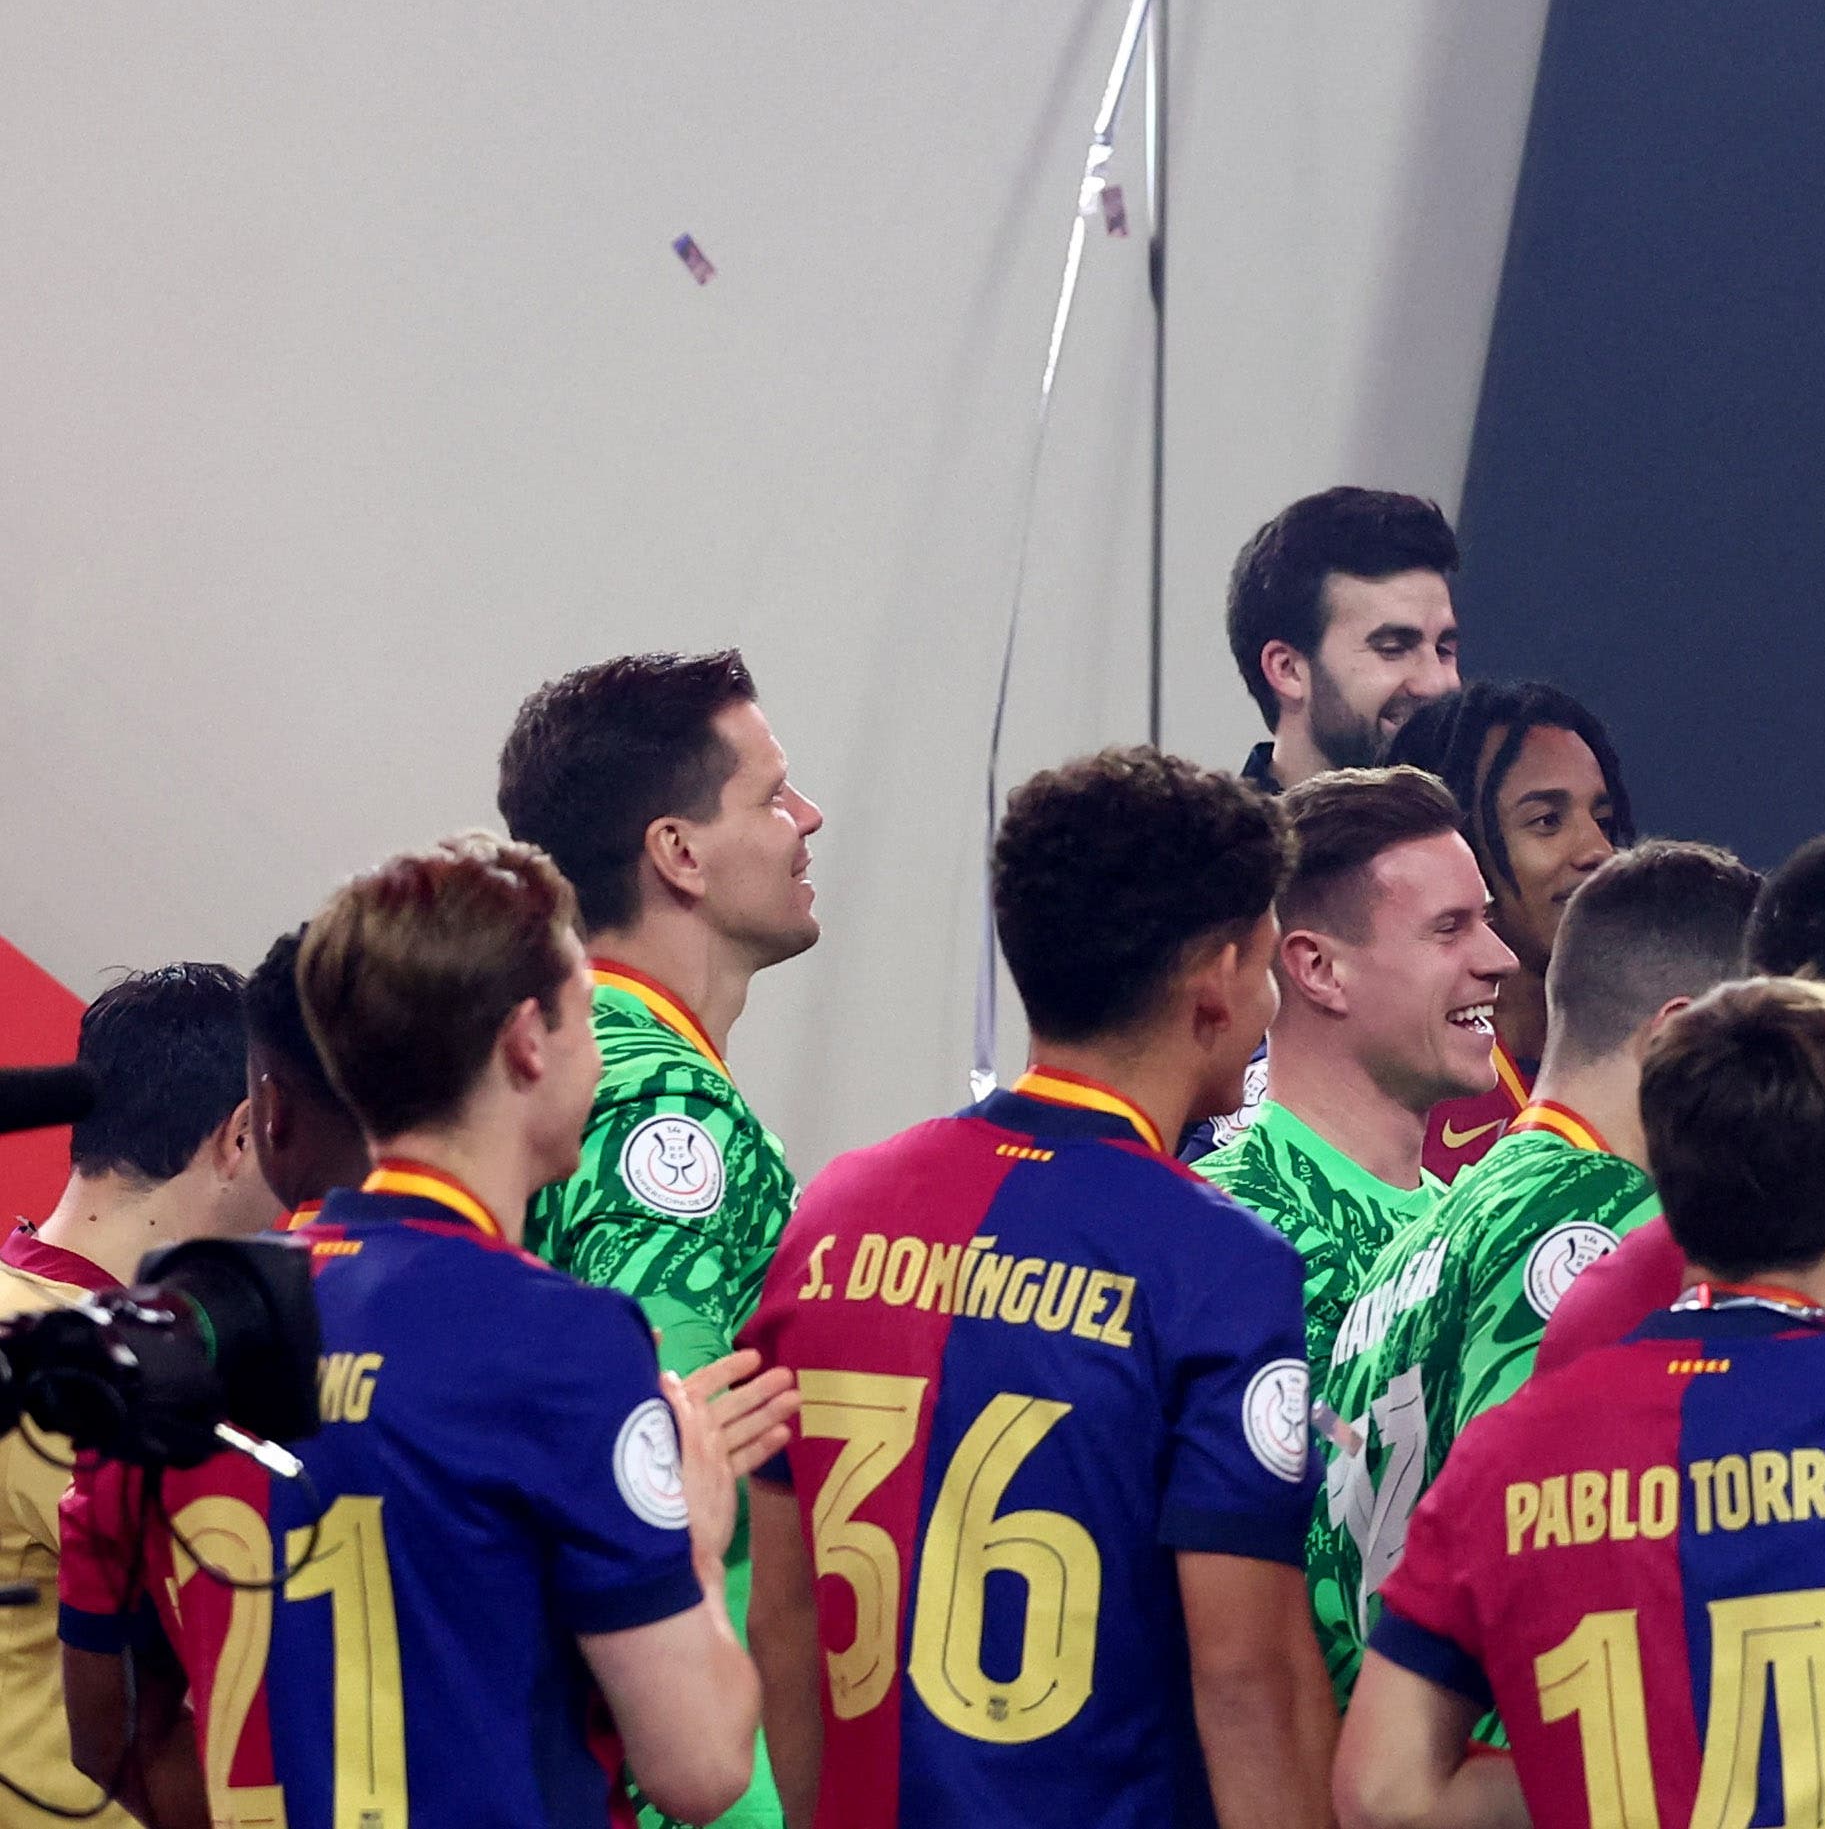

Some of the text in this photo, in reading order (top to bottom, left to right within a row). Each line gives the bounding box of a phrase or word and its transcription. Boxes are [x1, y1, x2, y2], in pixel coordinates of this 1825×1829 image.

[797, 1233, 1137, 1349] S. DOMÍNGUEZ
[796, 1369, 1102, 1745] 36
[1505, 1465, 1681, 1557] PABLO
[168, 1493, 409, 1829] 21
